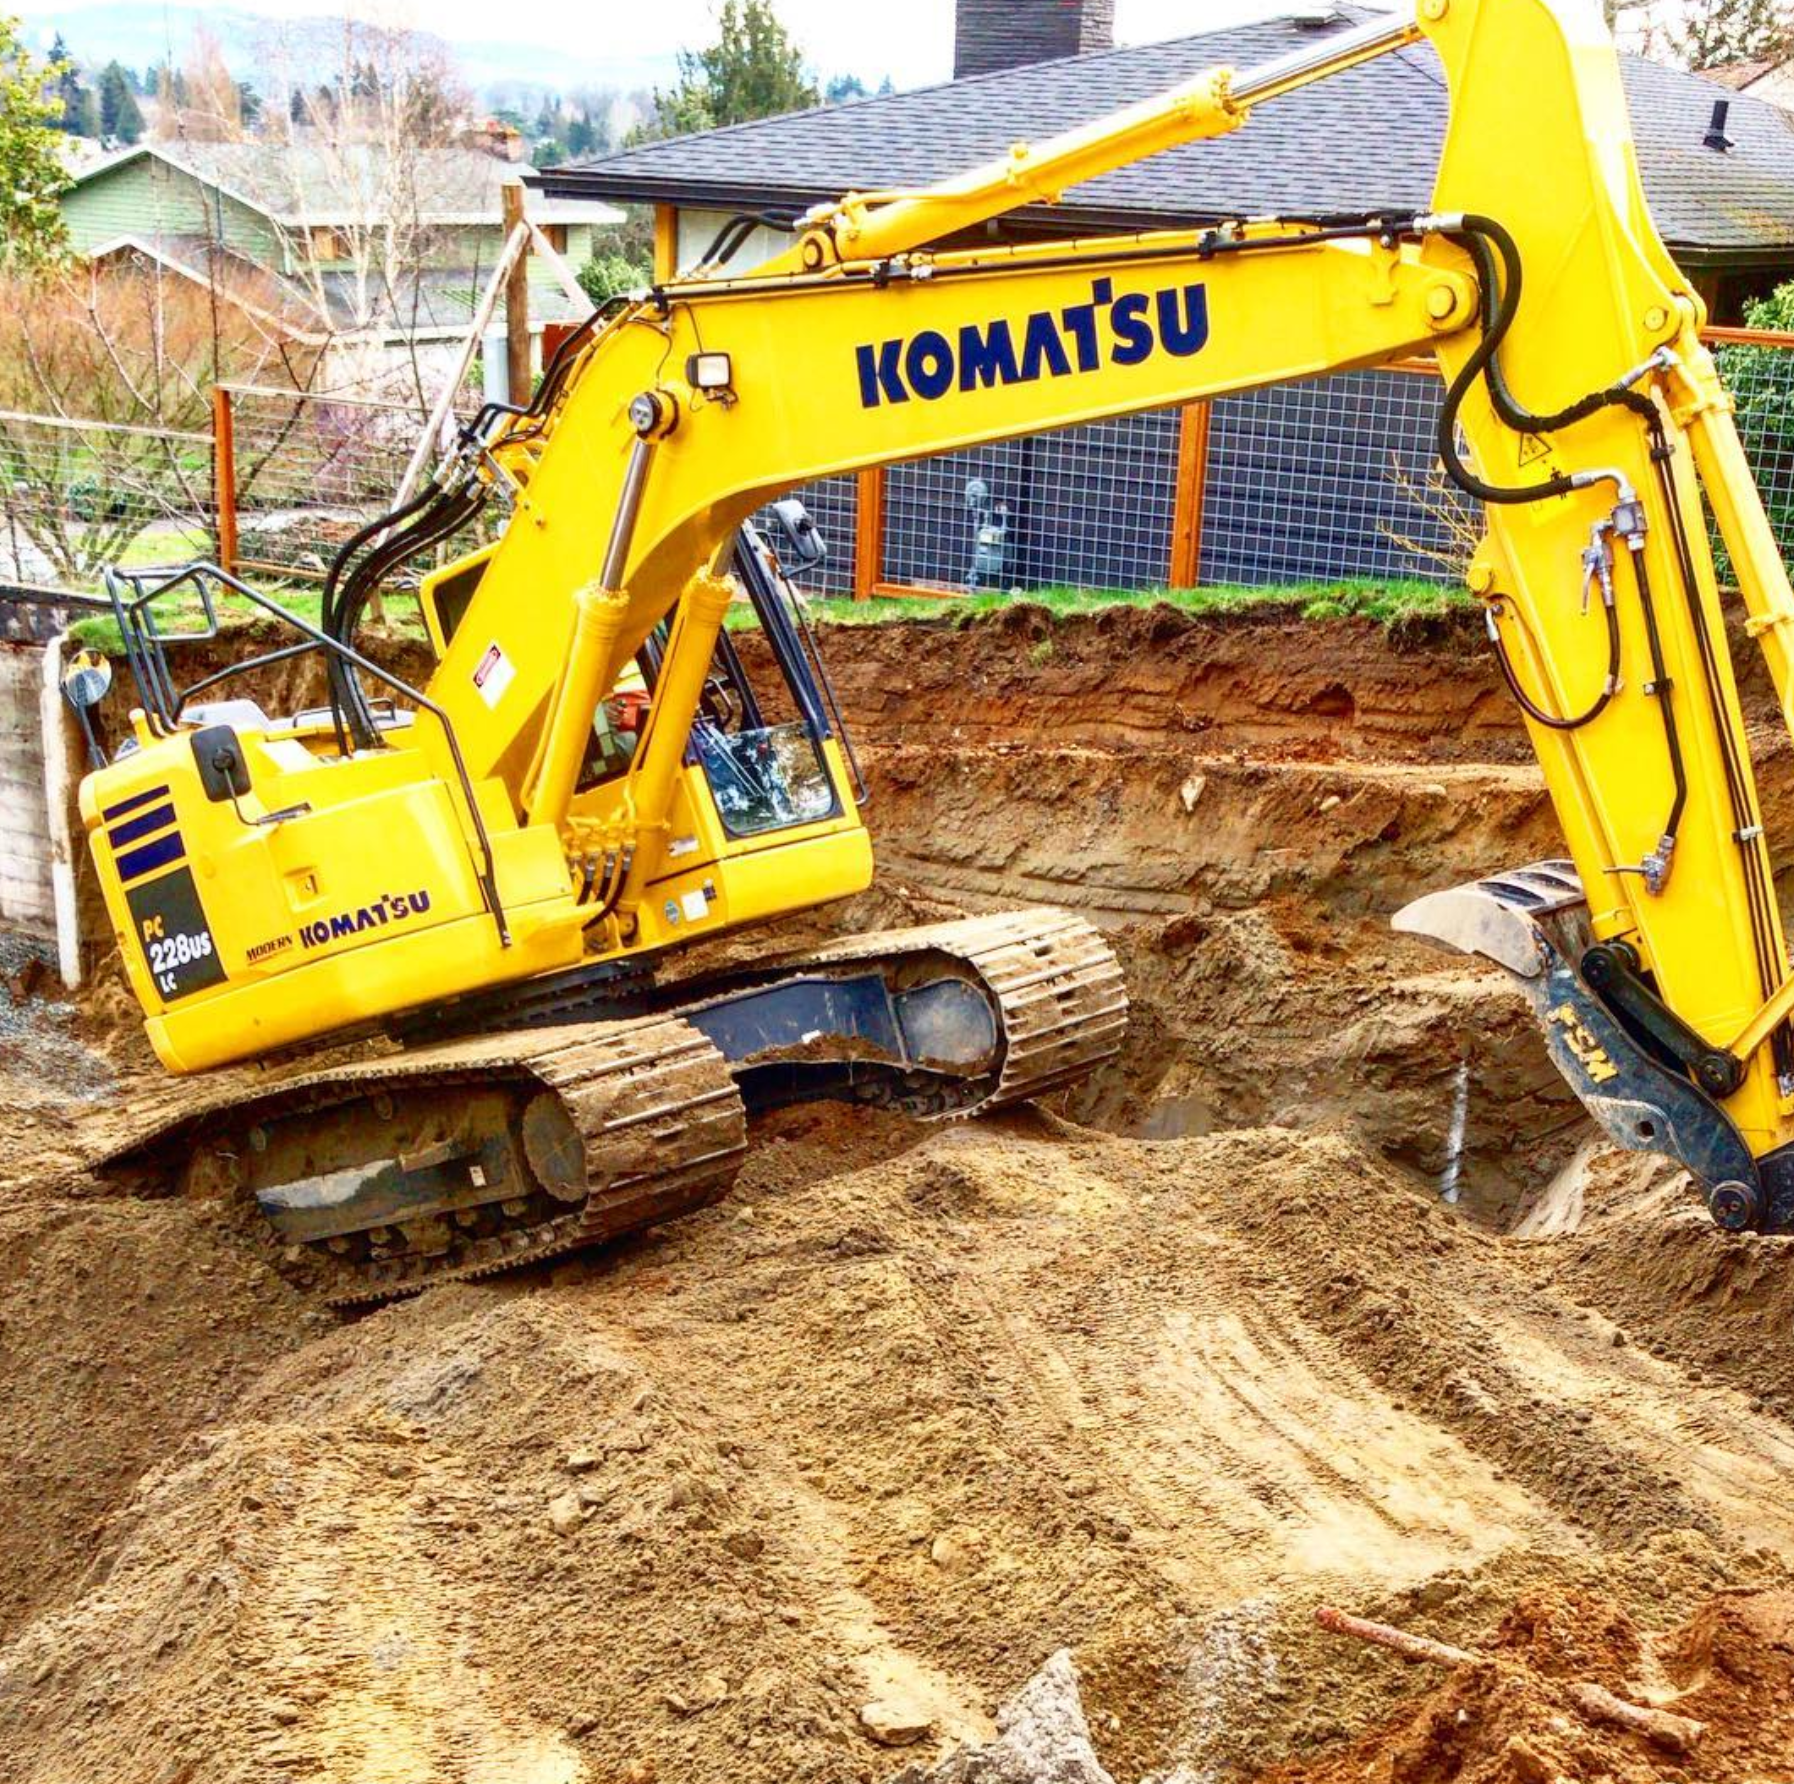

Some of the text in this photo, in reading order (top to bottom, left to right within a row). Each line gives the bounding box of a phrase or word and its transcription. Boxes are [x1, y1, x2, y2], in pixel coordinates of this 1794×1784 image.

[855, 277, 1209, 408] KOMATSU
[143, 915, 164, 942] PC
[299, 890, 430, 949] KOMATSU
[150, 931, 211, 974] 228US
[246, 934, 294, 961] MODERN
[160, 971, 177, 993] LC
